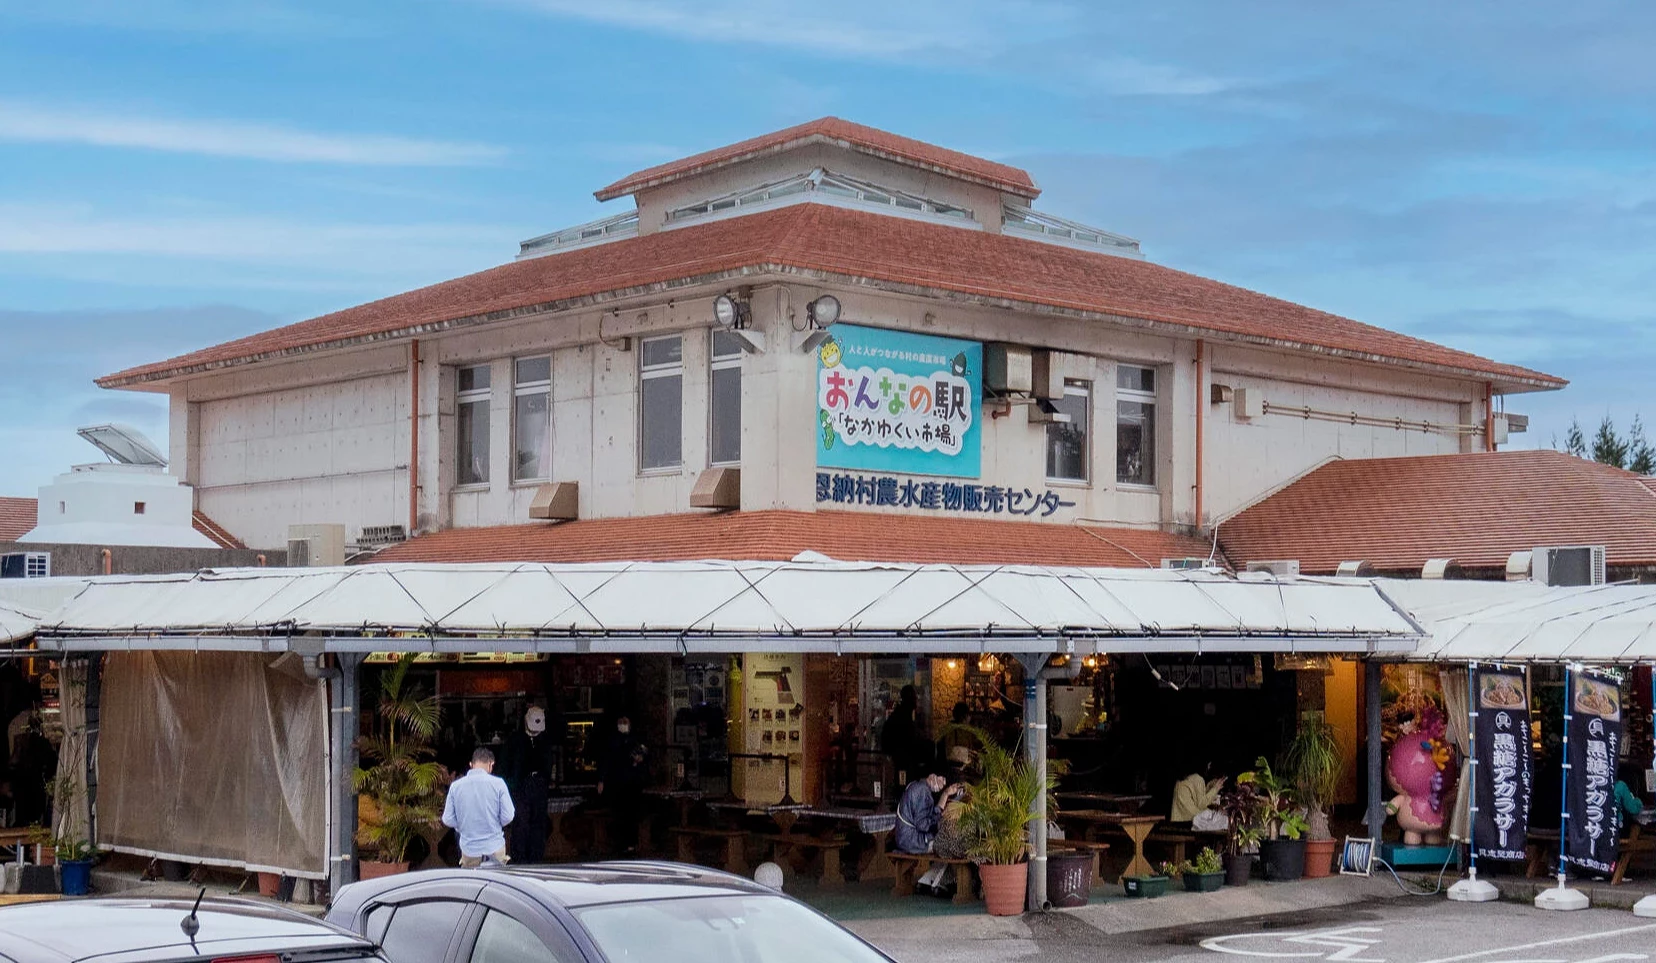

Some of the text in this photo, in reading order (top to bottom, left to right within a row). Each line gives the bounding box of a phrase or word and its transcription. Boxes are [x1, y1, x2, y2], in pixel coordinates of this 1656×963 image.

[826, 371, 967, 422] おんなの駅
[816, 472, 1076, 517] 恩納村農水産物販売センター
[1493, 733, 1518, 848] 黒糖アガラサー
[1585, 739, 1610, 857] 黒糖アガラサー
